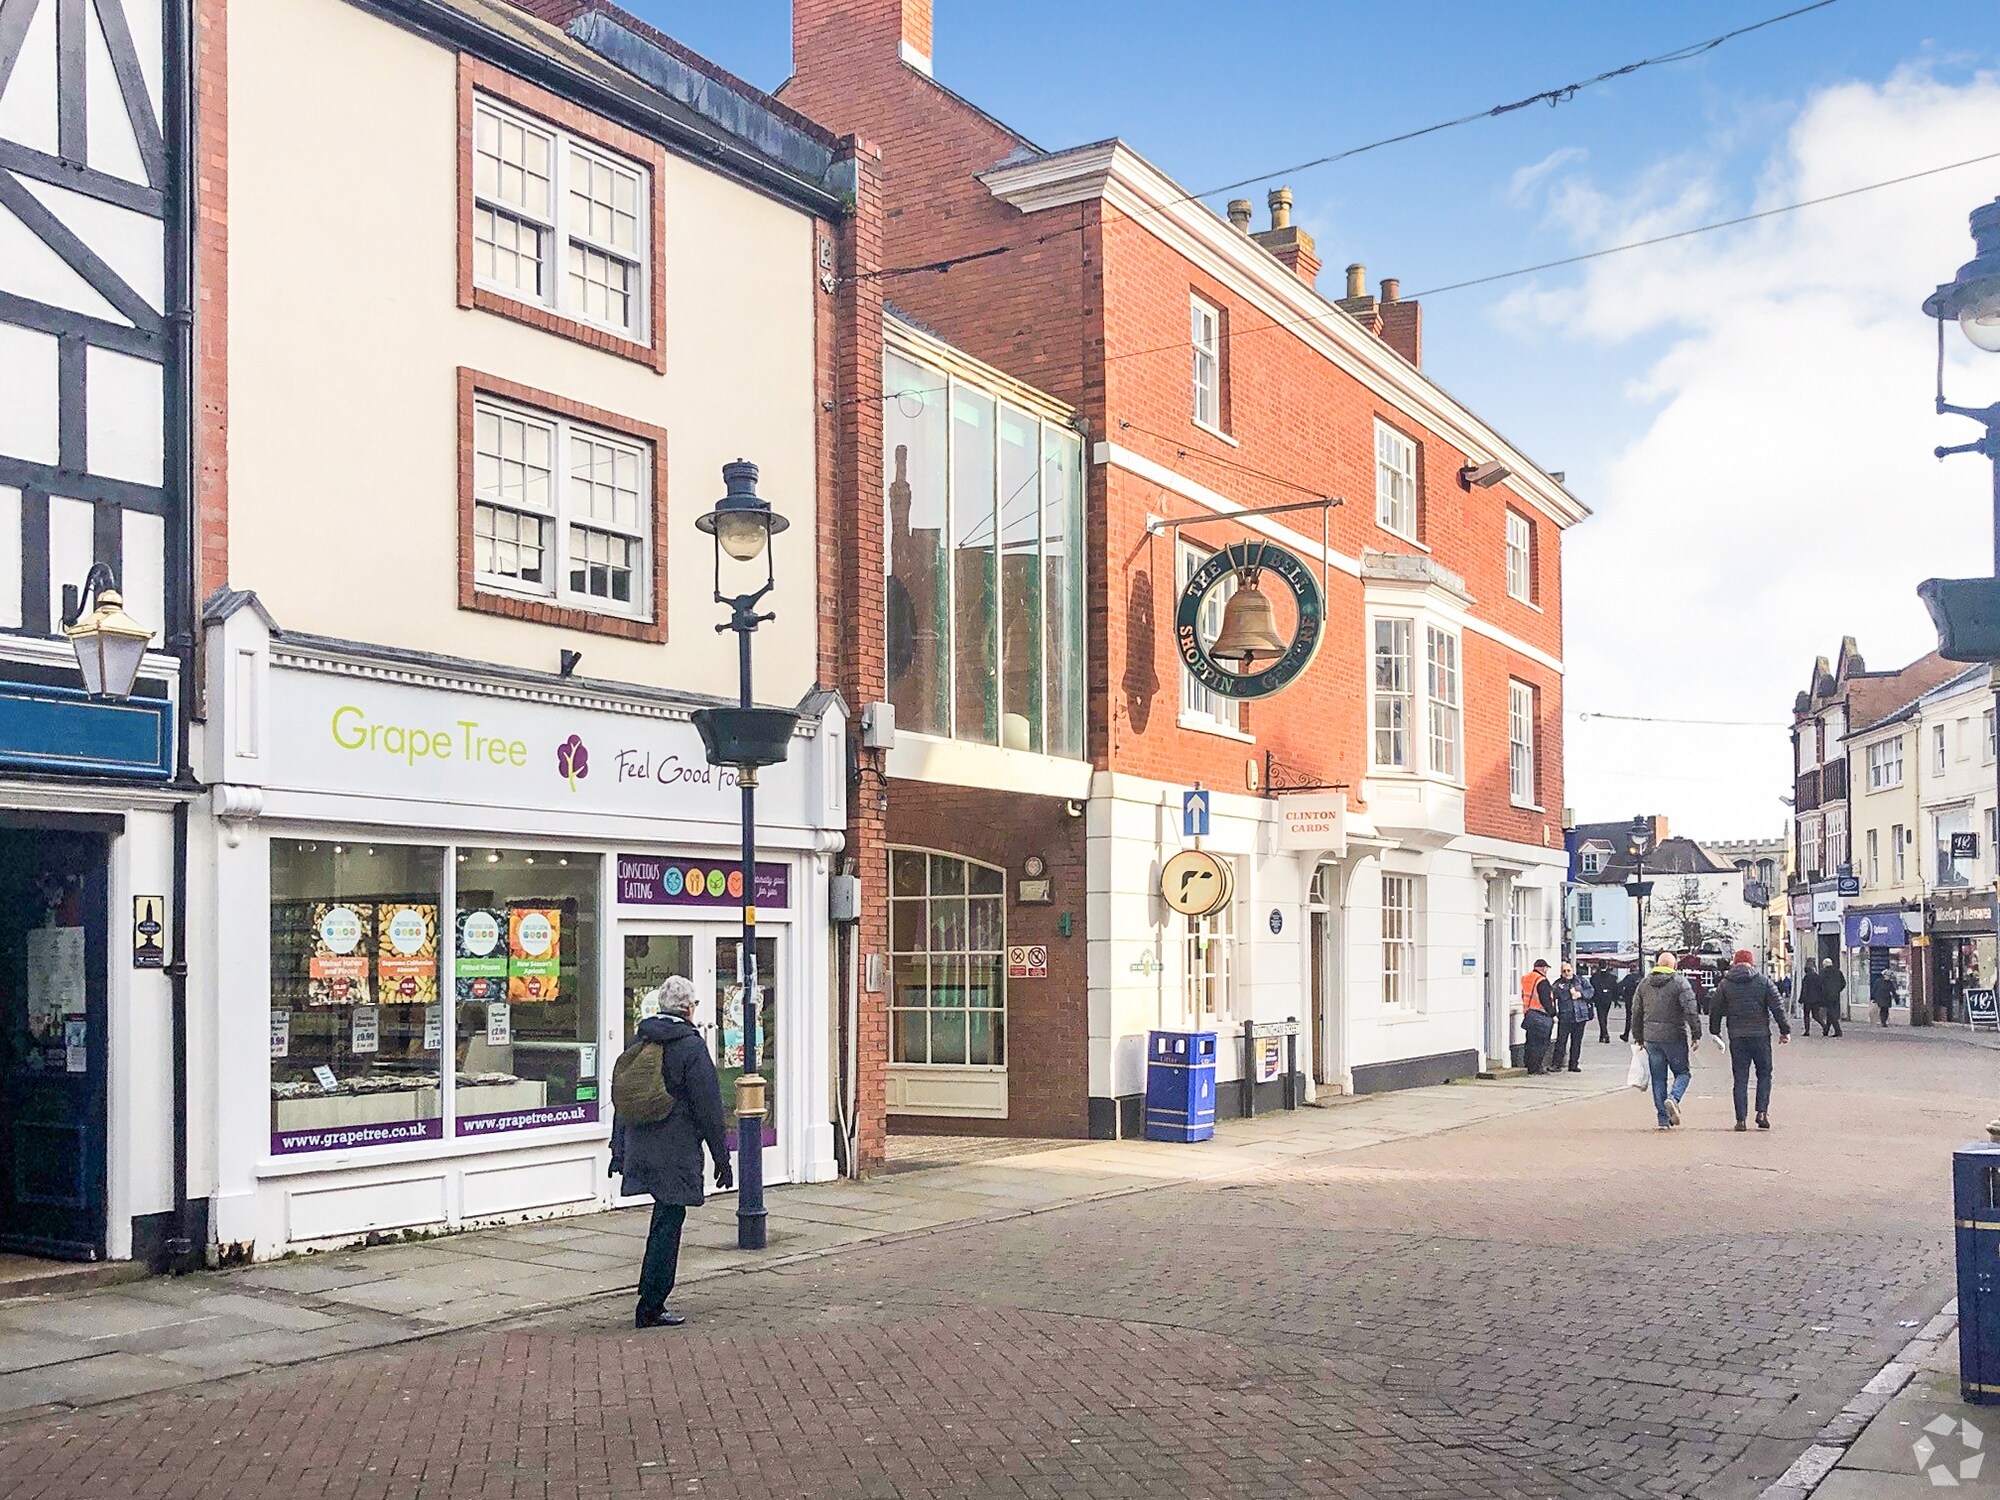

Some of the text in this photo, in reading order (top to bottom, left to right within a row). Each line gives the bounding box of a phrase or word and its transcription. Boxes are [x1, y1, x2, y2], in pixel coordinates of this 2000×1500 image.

[1187, 551, 1310, 599] THE BELL
[1178, 624, 1249, 697] SHOPPING
[614, 749, 650, 783] Feel
[656, 755, 711, 785] Good
[1285, 811, 1337, 821] CLINTON
[1291, 823, 1331, 833] CARDS
[1056, 910, 1073, 938] 4
[463, 1106, 586, 1132] www.grapetree.co.uk
[282, 1122, 427, 1149] www.grapetree.co.uk
